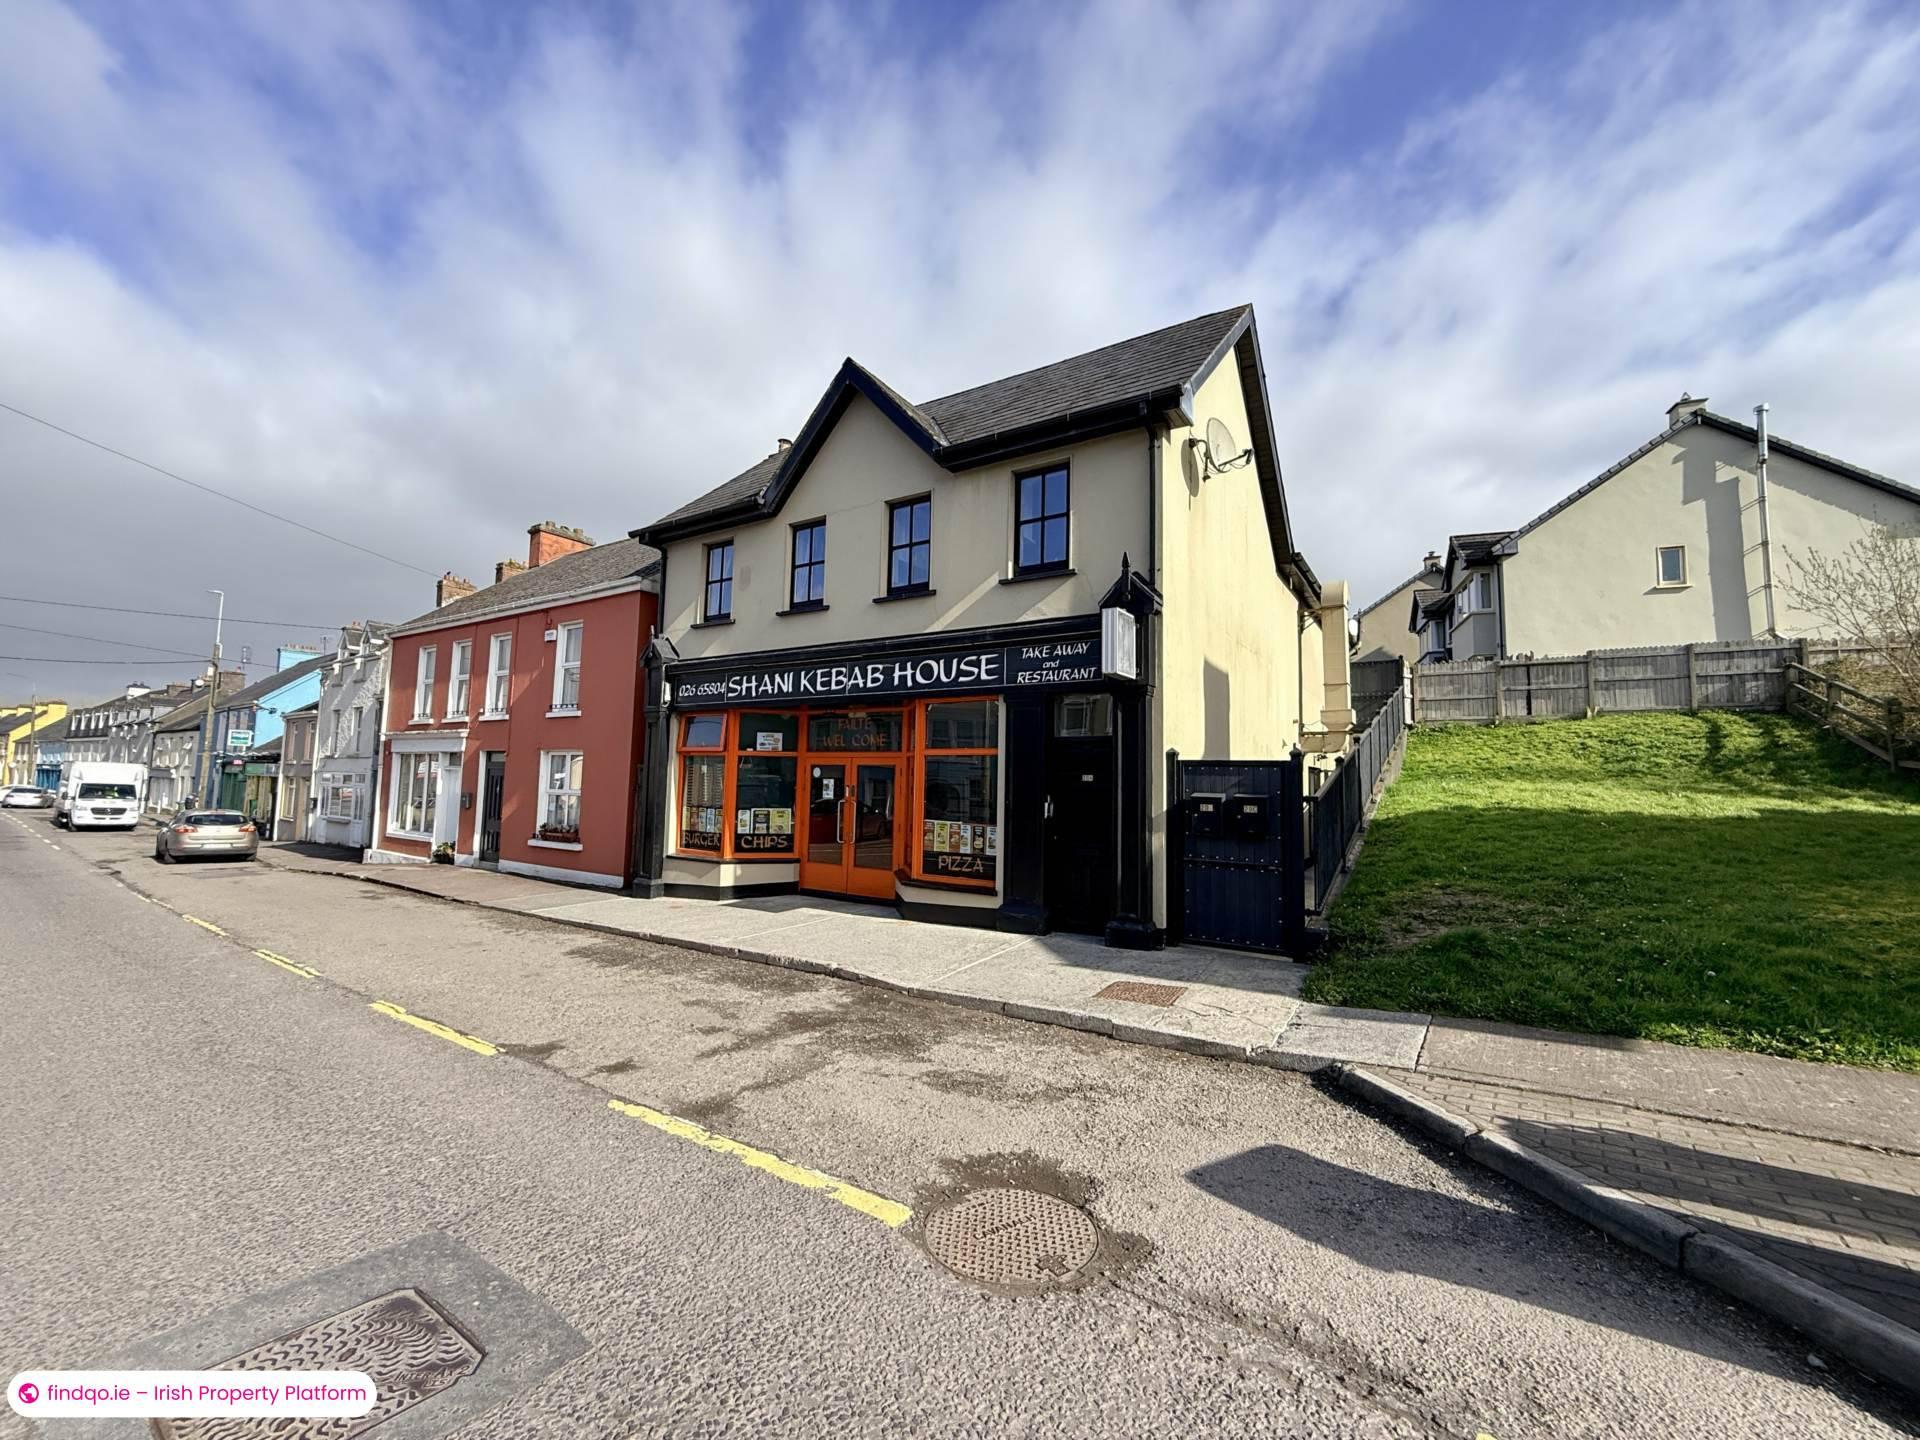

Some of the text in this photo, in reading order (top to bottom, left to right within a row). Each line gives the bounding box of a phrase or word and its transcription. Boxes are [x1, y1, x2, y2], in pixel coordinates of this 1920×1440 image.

[1021, 642, 1091, 659] TAKE AWAY
[1042, 659, 1060, 669] and
[728, 654, 999, 698] SHANI KEBAB HOUSE
[1017, 667, 1097, 684] RESTAURANT
[679, 682, 726, 697] 026 65804
[741, 835, 788, 848] CHIPS
[938, 855, 984, 873] PIZZA
